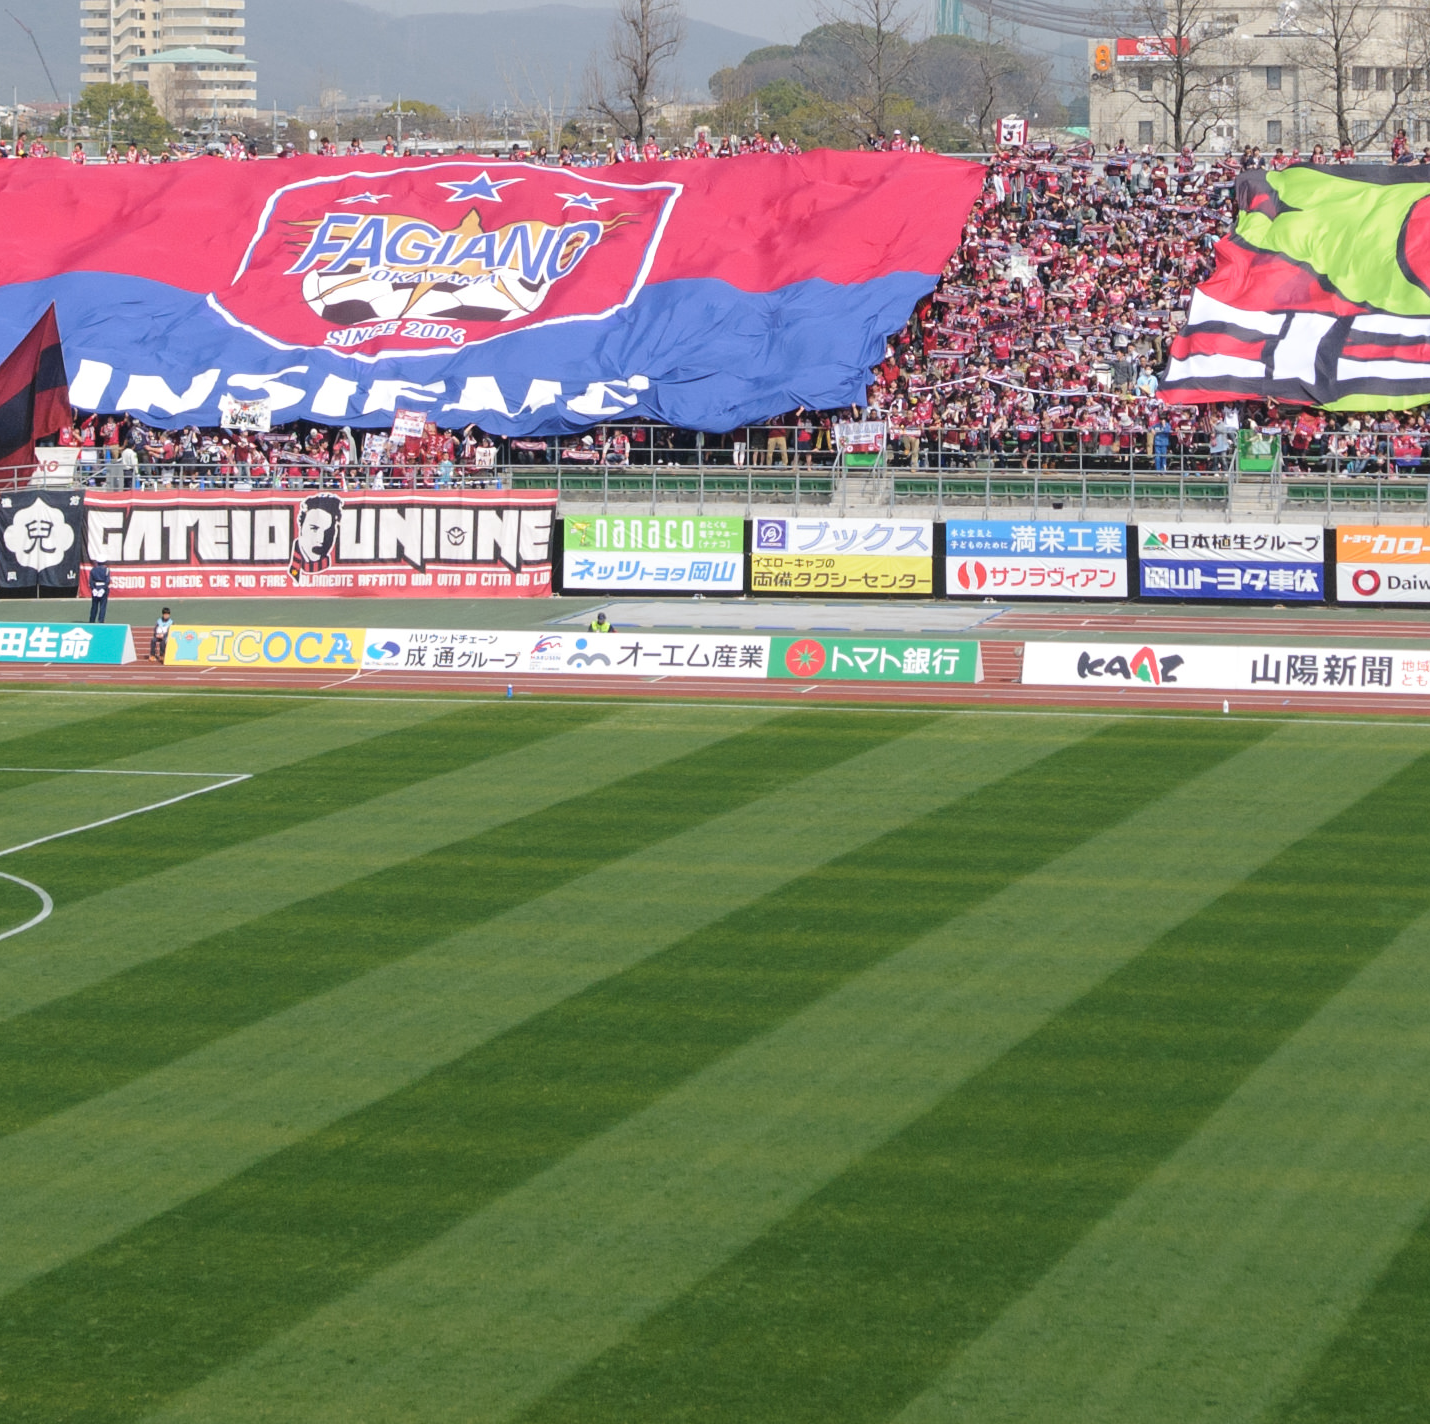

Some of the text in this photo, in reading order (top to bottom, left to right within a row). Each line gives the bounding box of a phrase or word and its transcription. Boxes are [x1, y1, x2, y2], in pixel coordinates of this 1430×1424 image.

[285, 213, 603, 283] FAGIANO
[370, 268, 499, 286] OKAYAMA
[325, 320, 467, 347] SINCE 2004
[335, 506, 554, 568] UNIONE
[595, 518, 695, 550] nanaco
[797, 521, 929, 552] ブックス
[1010, 525, 1123, 554] 満栄工業
[1170, 533, 1322, 552] 日本植生グループ
[571, 560, 737, 584] ネッツトヨタ岡山
[752, 558, 836, 569] イエローキャブの
[752, 571, 932, 589] 両備タクシーセンター
[990, 567, 1116, 589] サンラヴィアン
[206, 629, 355, 664] ICOCA
[409, 633, 499, 645] ハリウッドチェーン
[618, 642, 765, 670] オーエム産業
[830, 645, 961, 677] トマト銀行
[1250, 653, 1394, 687] 山陽新聞
